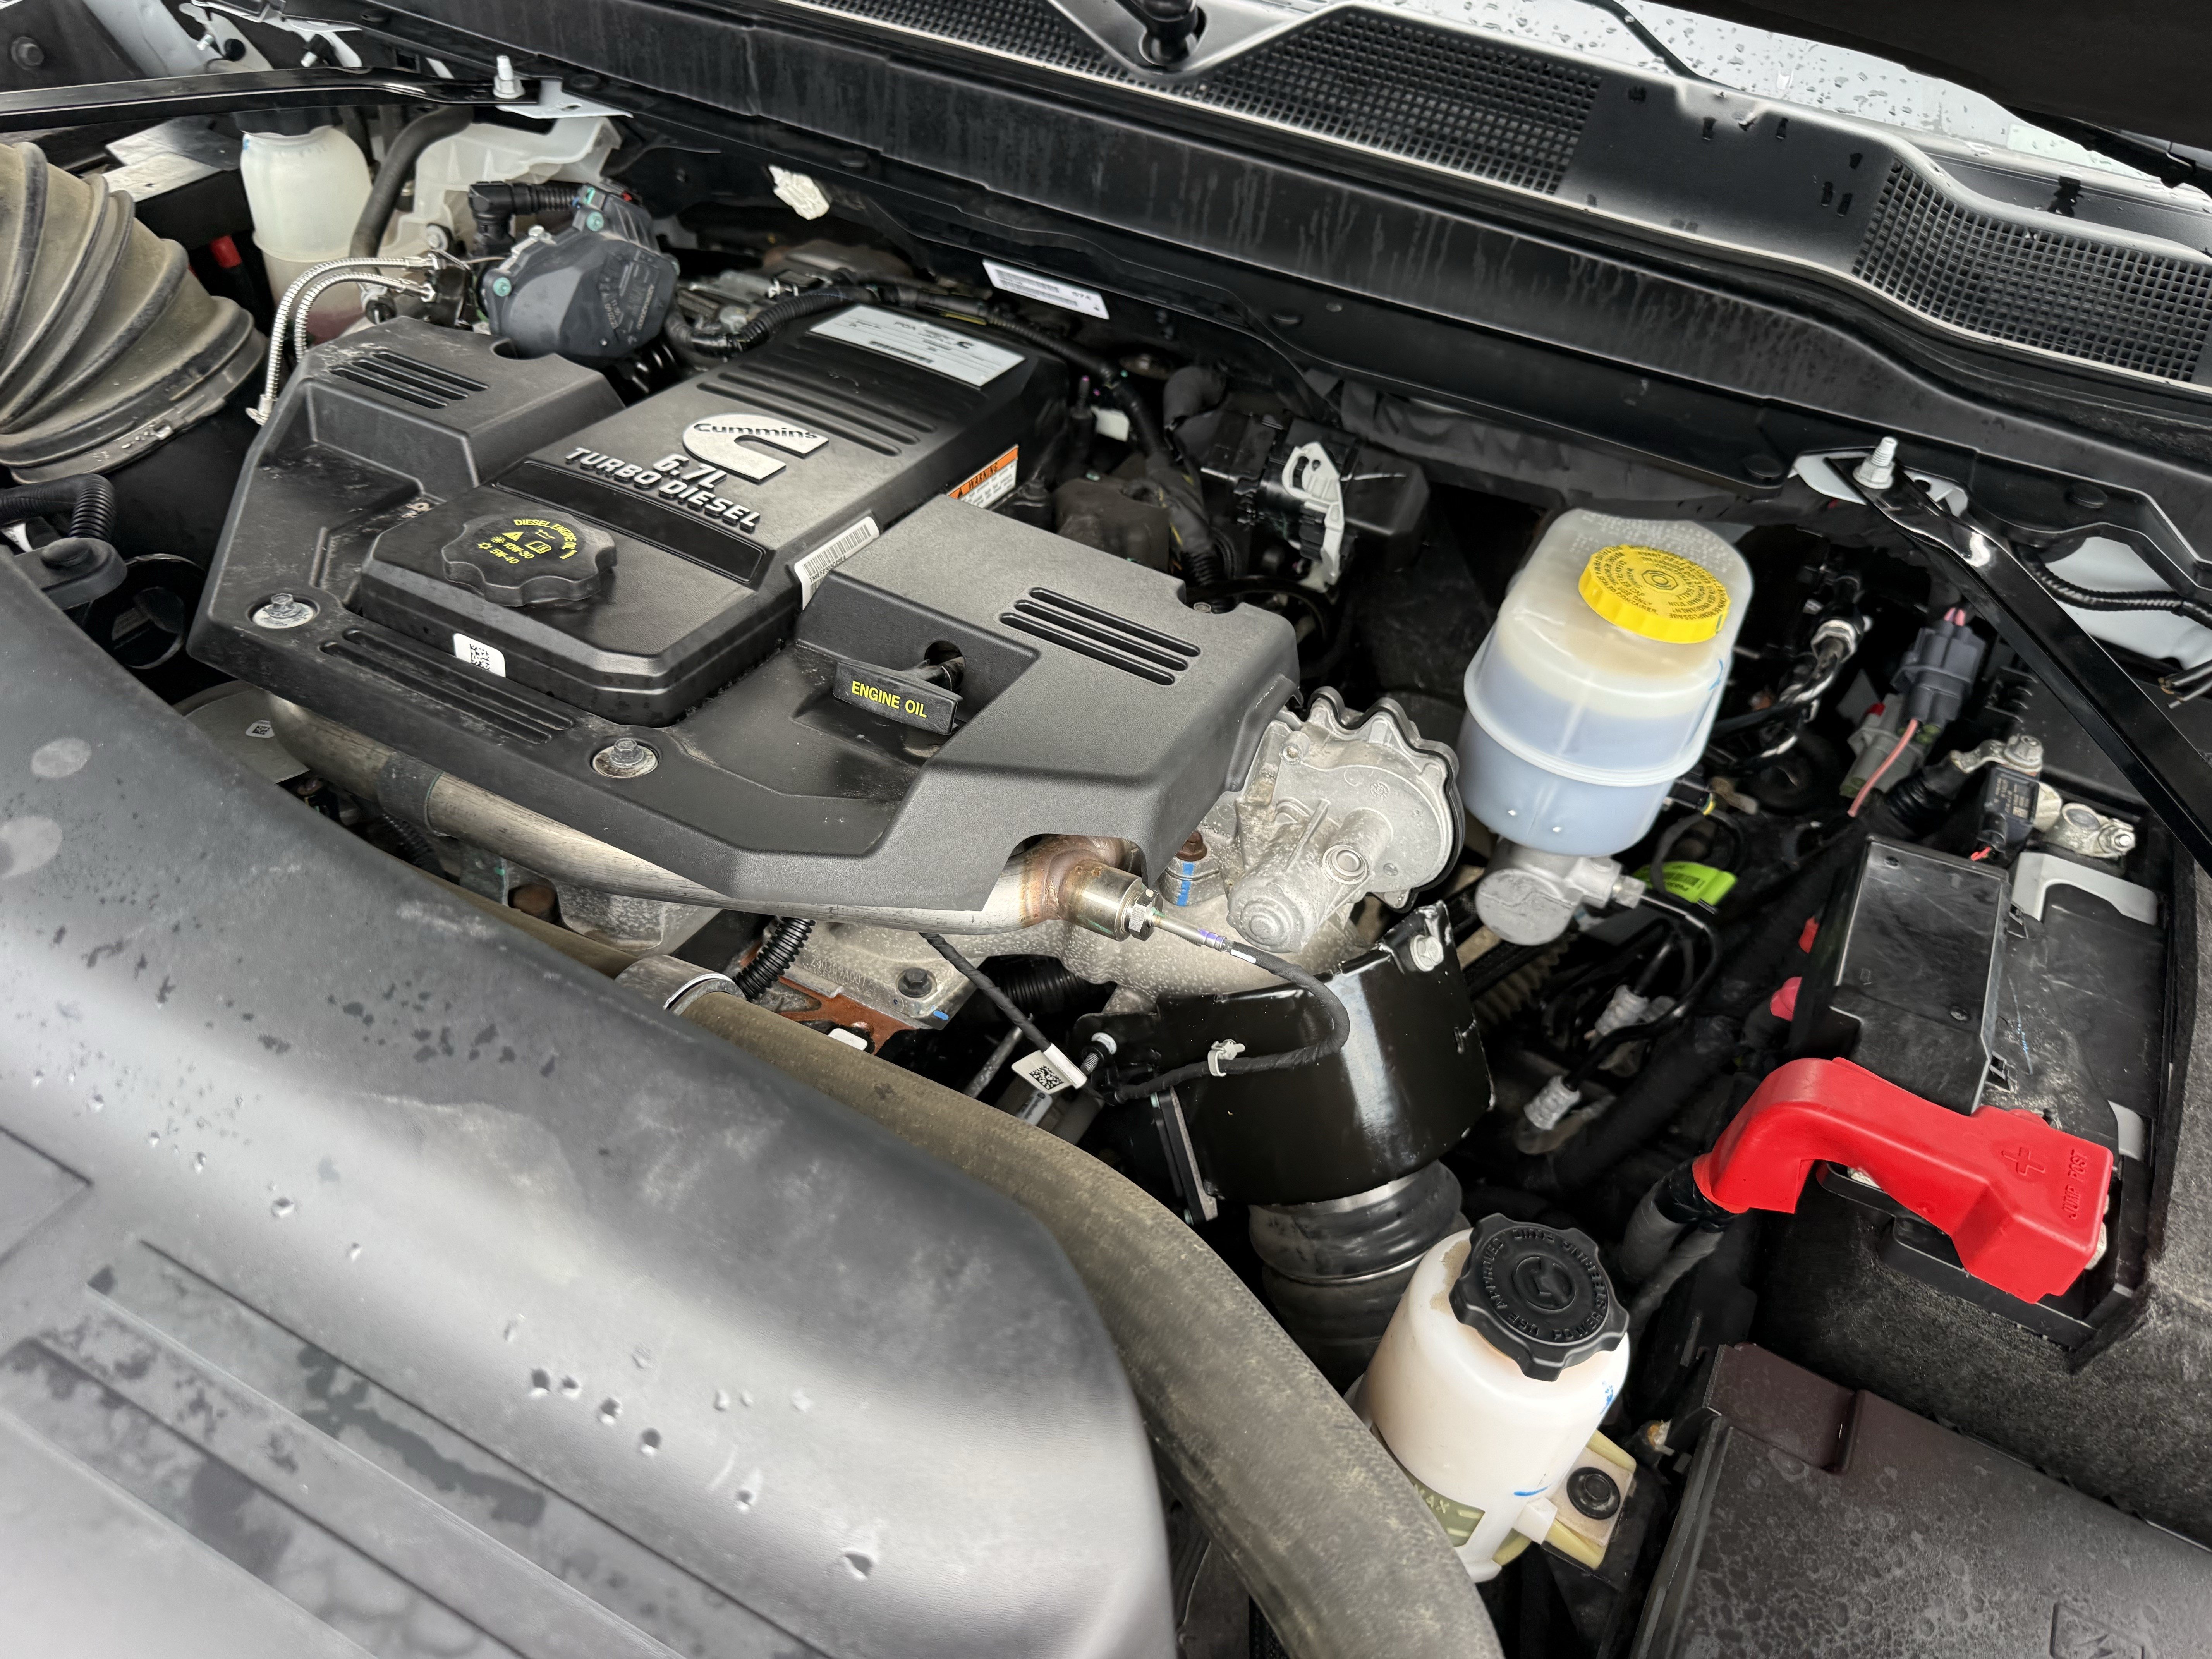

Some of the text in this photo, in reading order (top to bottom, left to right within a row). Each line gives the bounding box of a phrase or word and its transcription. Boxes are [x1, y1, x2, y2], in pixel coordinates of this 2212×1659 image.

[694, 423, 819, 440] Cummins
[565, 447, 761, 532] TURBO DIESEL
[653, 453, 727, 492] 6.7L
[503, 542, 535, 559] 10W-30
[514, 519, 577, 550] DIESEL ENGINE OIL
[489, 548, 520, 564] 5W-40
[852, 680, 927, 718] ENGINE OIL
[2061, 1149, 2088, 1221] JUMP POST
[1483, 1238, 1539, 1336] USE APPROVED
[1561, 1240, 1607, 1310] STEERING
[1552, 1311, 1602, 1342] POWER
